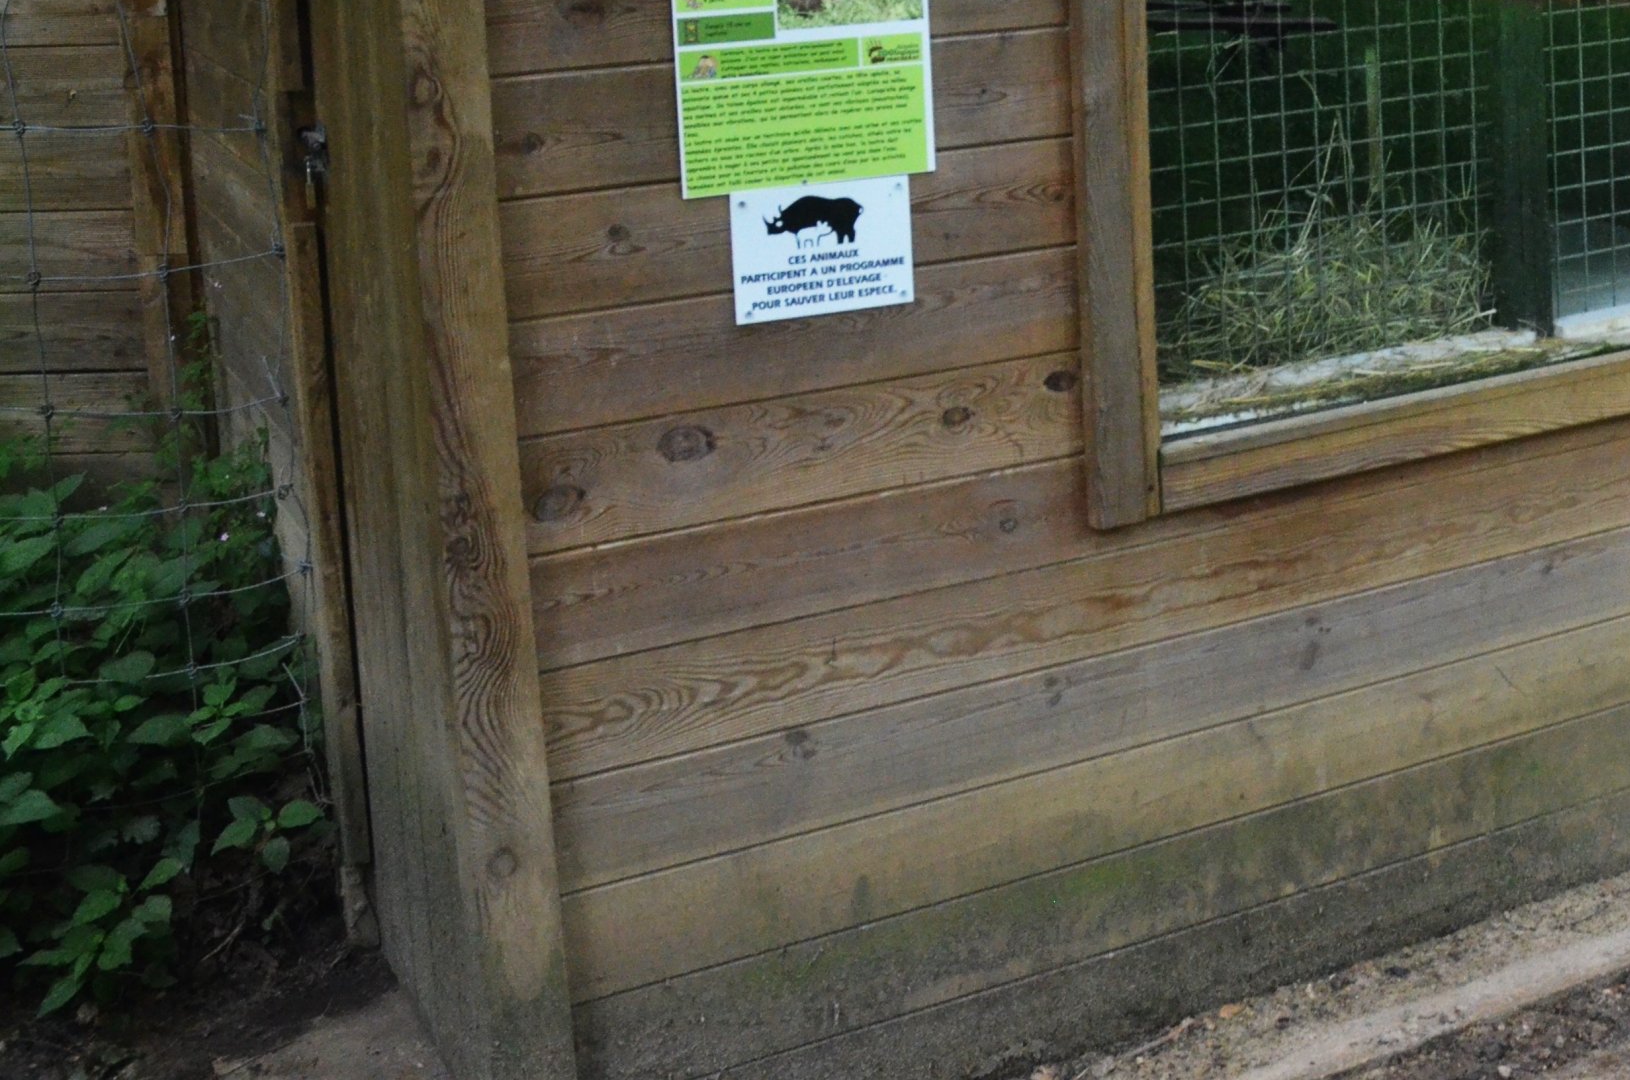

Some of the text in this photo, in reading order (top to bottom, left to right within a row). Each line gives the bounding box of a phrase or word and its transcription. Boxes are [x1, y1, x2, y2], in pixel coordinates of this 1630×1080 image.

[788, 249, 859, 265] CES ANIMAUX
[741, 256, 905, 284] PARTICIPENT A UN PROGRAMME
[767, 273, 882, 295] EUROPEEN D'ELEVAGE
[752, 298, 781, 311] POUR
[785, 291, 825, 307] SAUVER
[829, 290, 855, 302] LEUR
